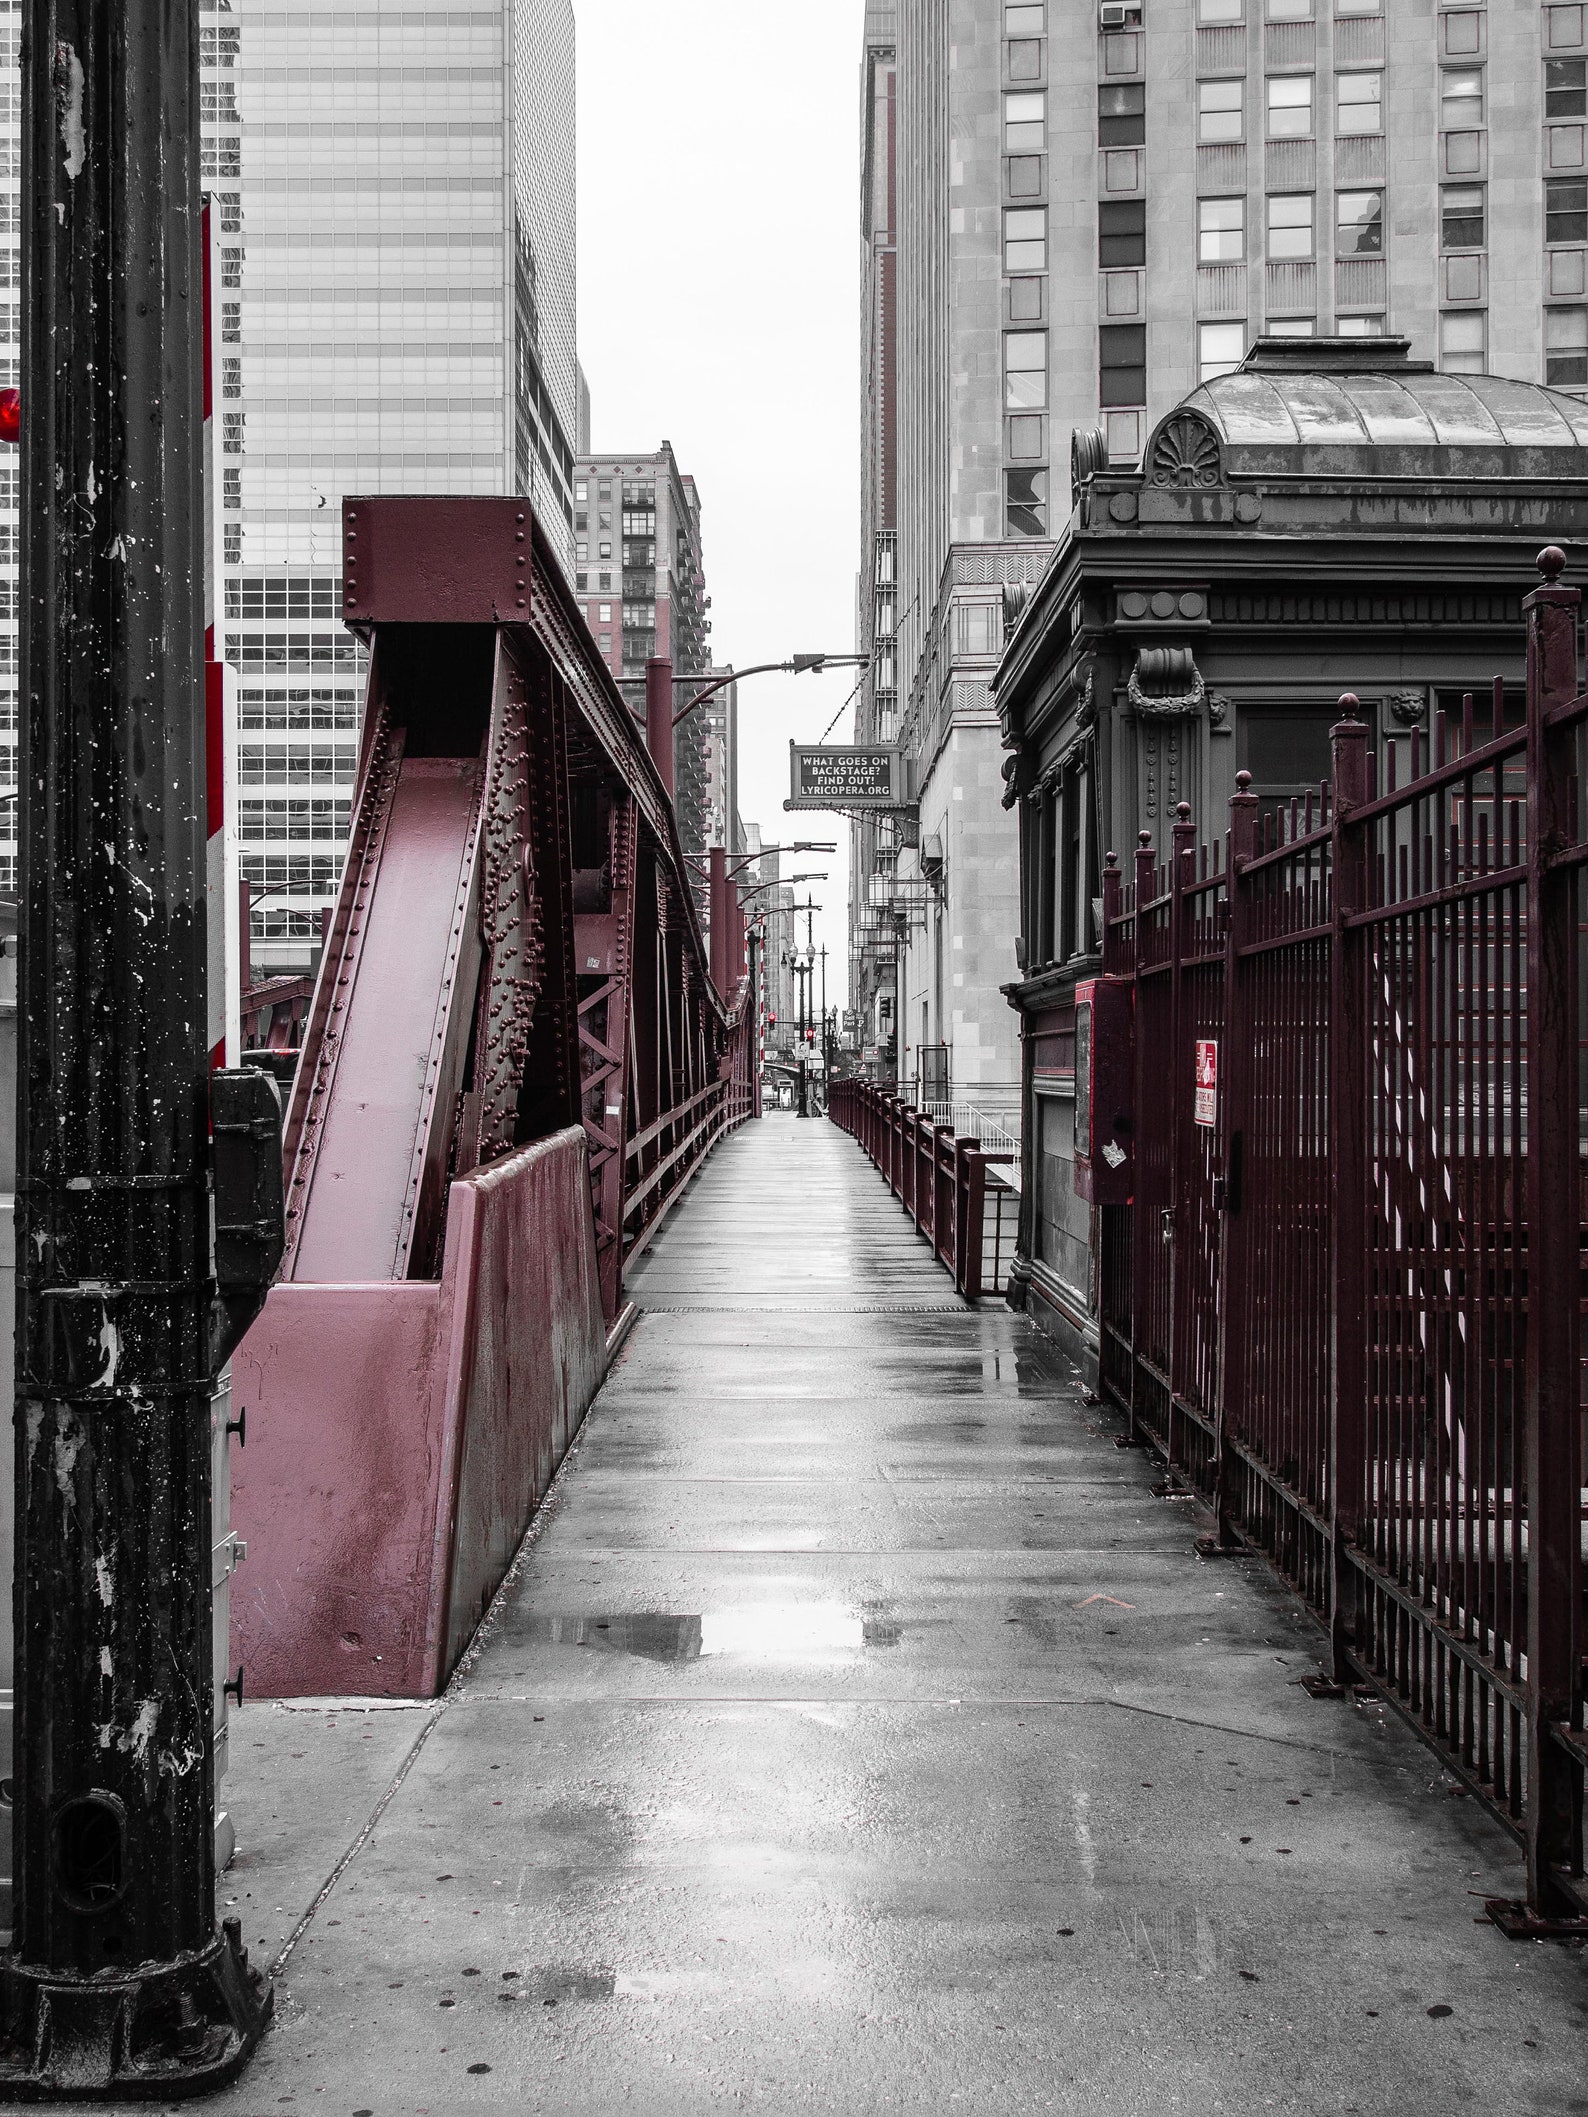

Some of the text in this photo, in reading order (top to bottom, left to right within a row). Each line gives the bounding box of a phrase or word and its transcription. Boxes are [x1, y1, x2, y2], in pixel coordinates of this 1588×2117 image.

[803, 757, 888, 766] WHAT GOES ON
[812, 767, 881, 775] BACKSTAGE?
[818, 777, 875, 785] FIND OUT!
[801, 786, 890, 795] LYRICOPERA.ORG
